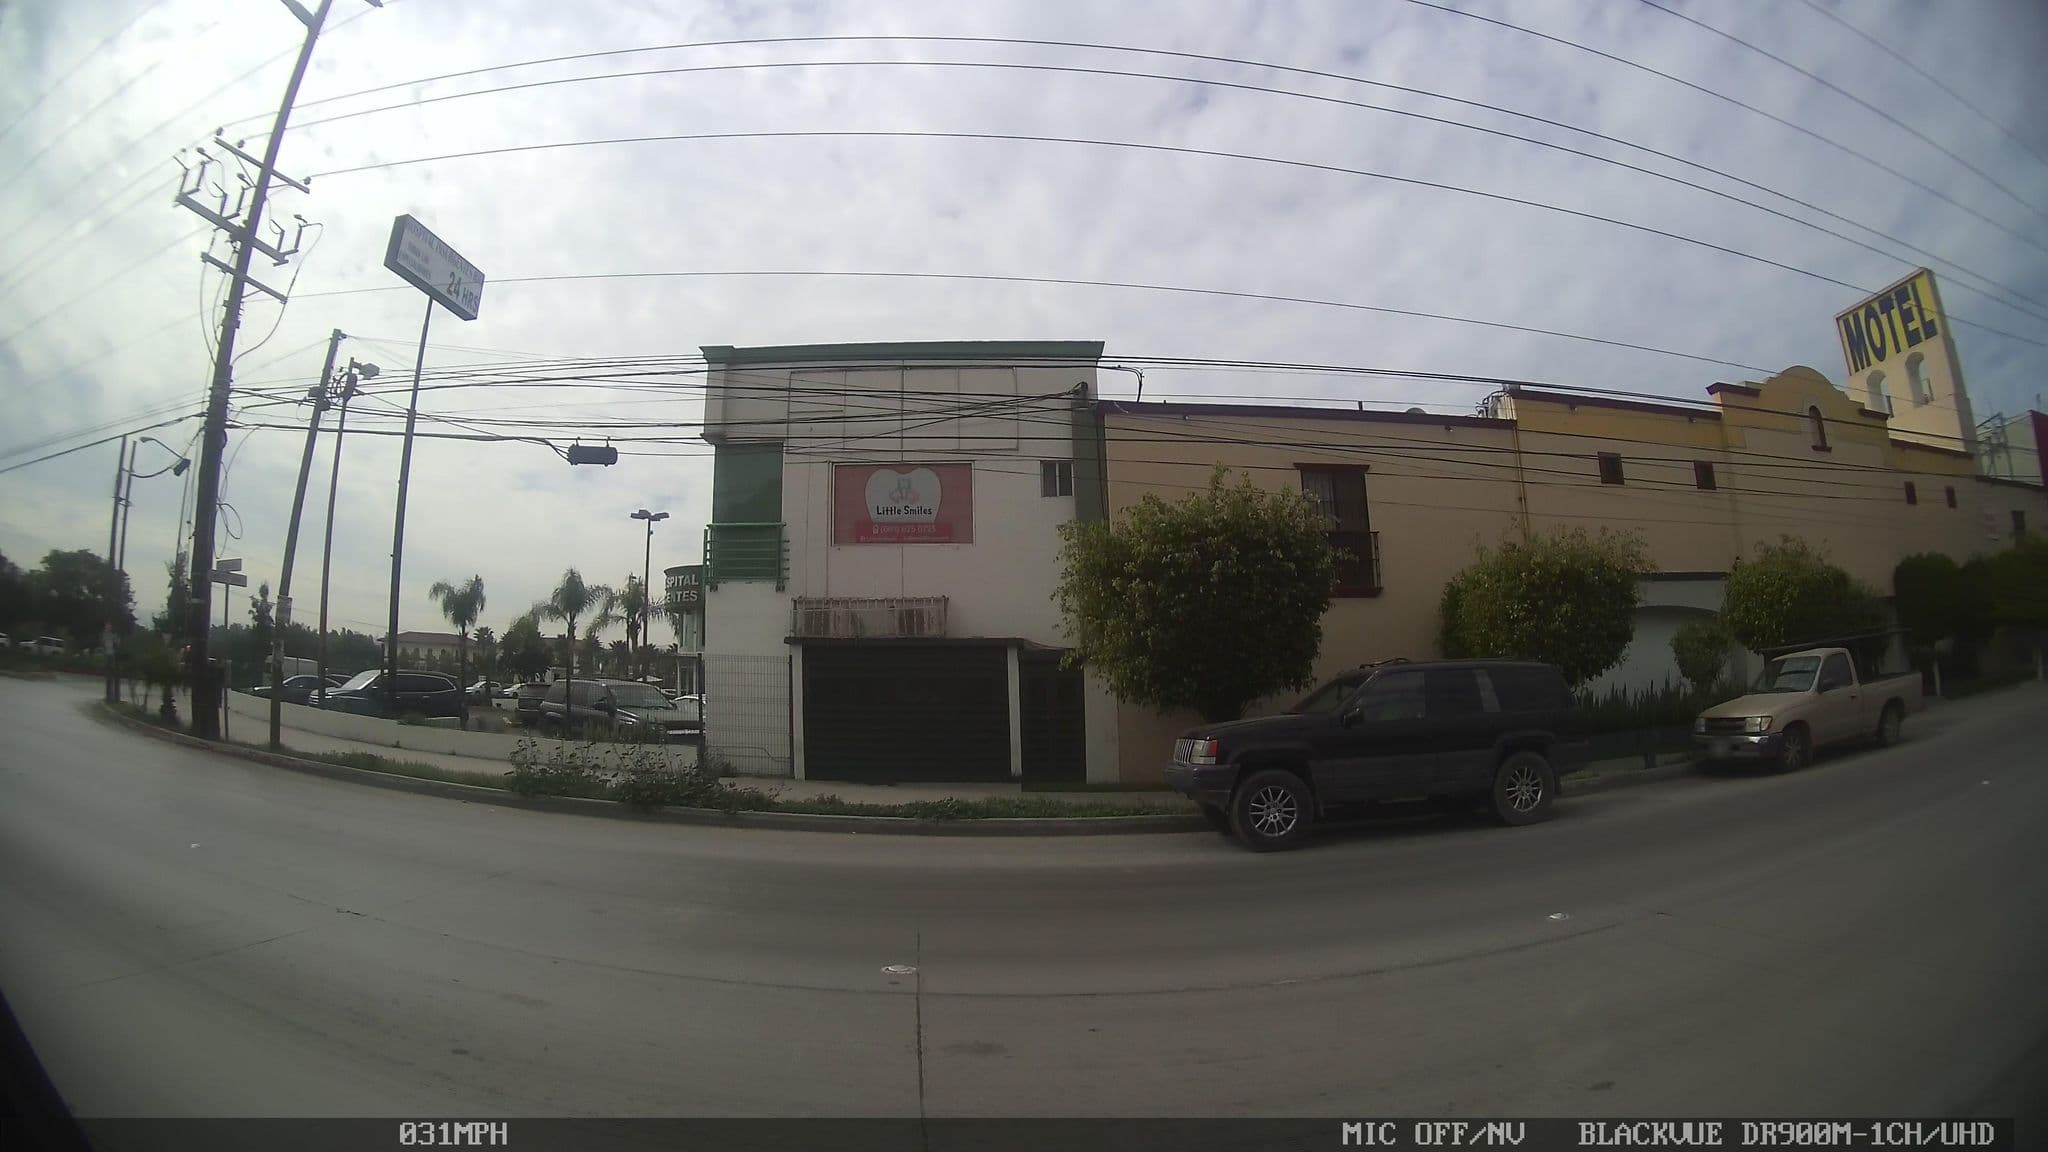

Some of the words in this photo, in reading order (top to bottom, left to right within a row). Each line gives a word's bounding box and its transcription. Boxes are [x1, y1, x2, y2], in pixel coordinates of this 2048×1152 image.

[447, 272, 462, 300] 24
[462, 287, 480, 313] HRS
[1843, 281, 1938, 373] MOTEL
[876, 504, 901, 515] Little
[904, 504, 932, 515] Smiles
